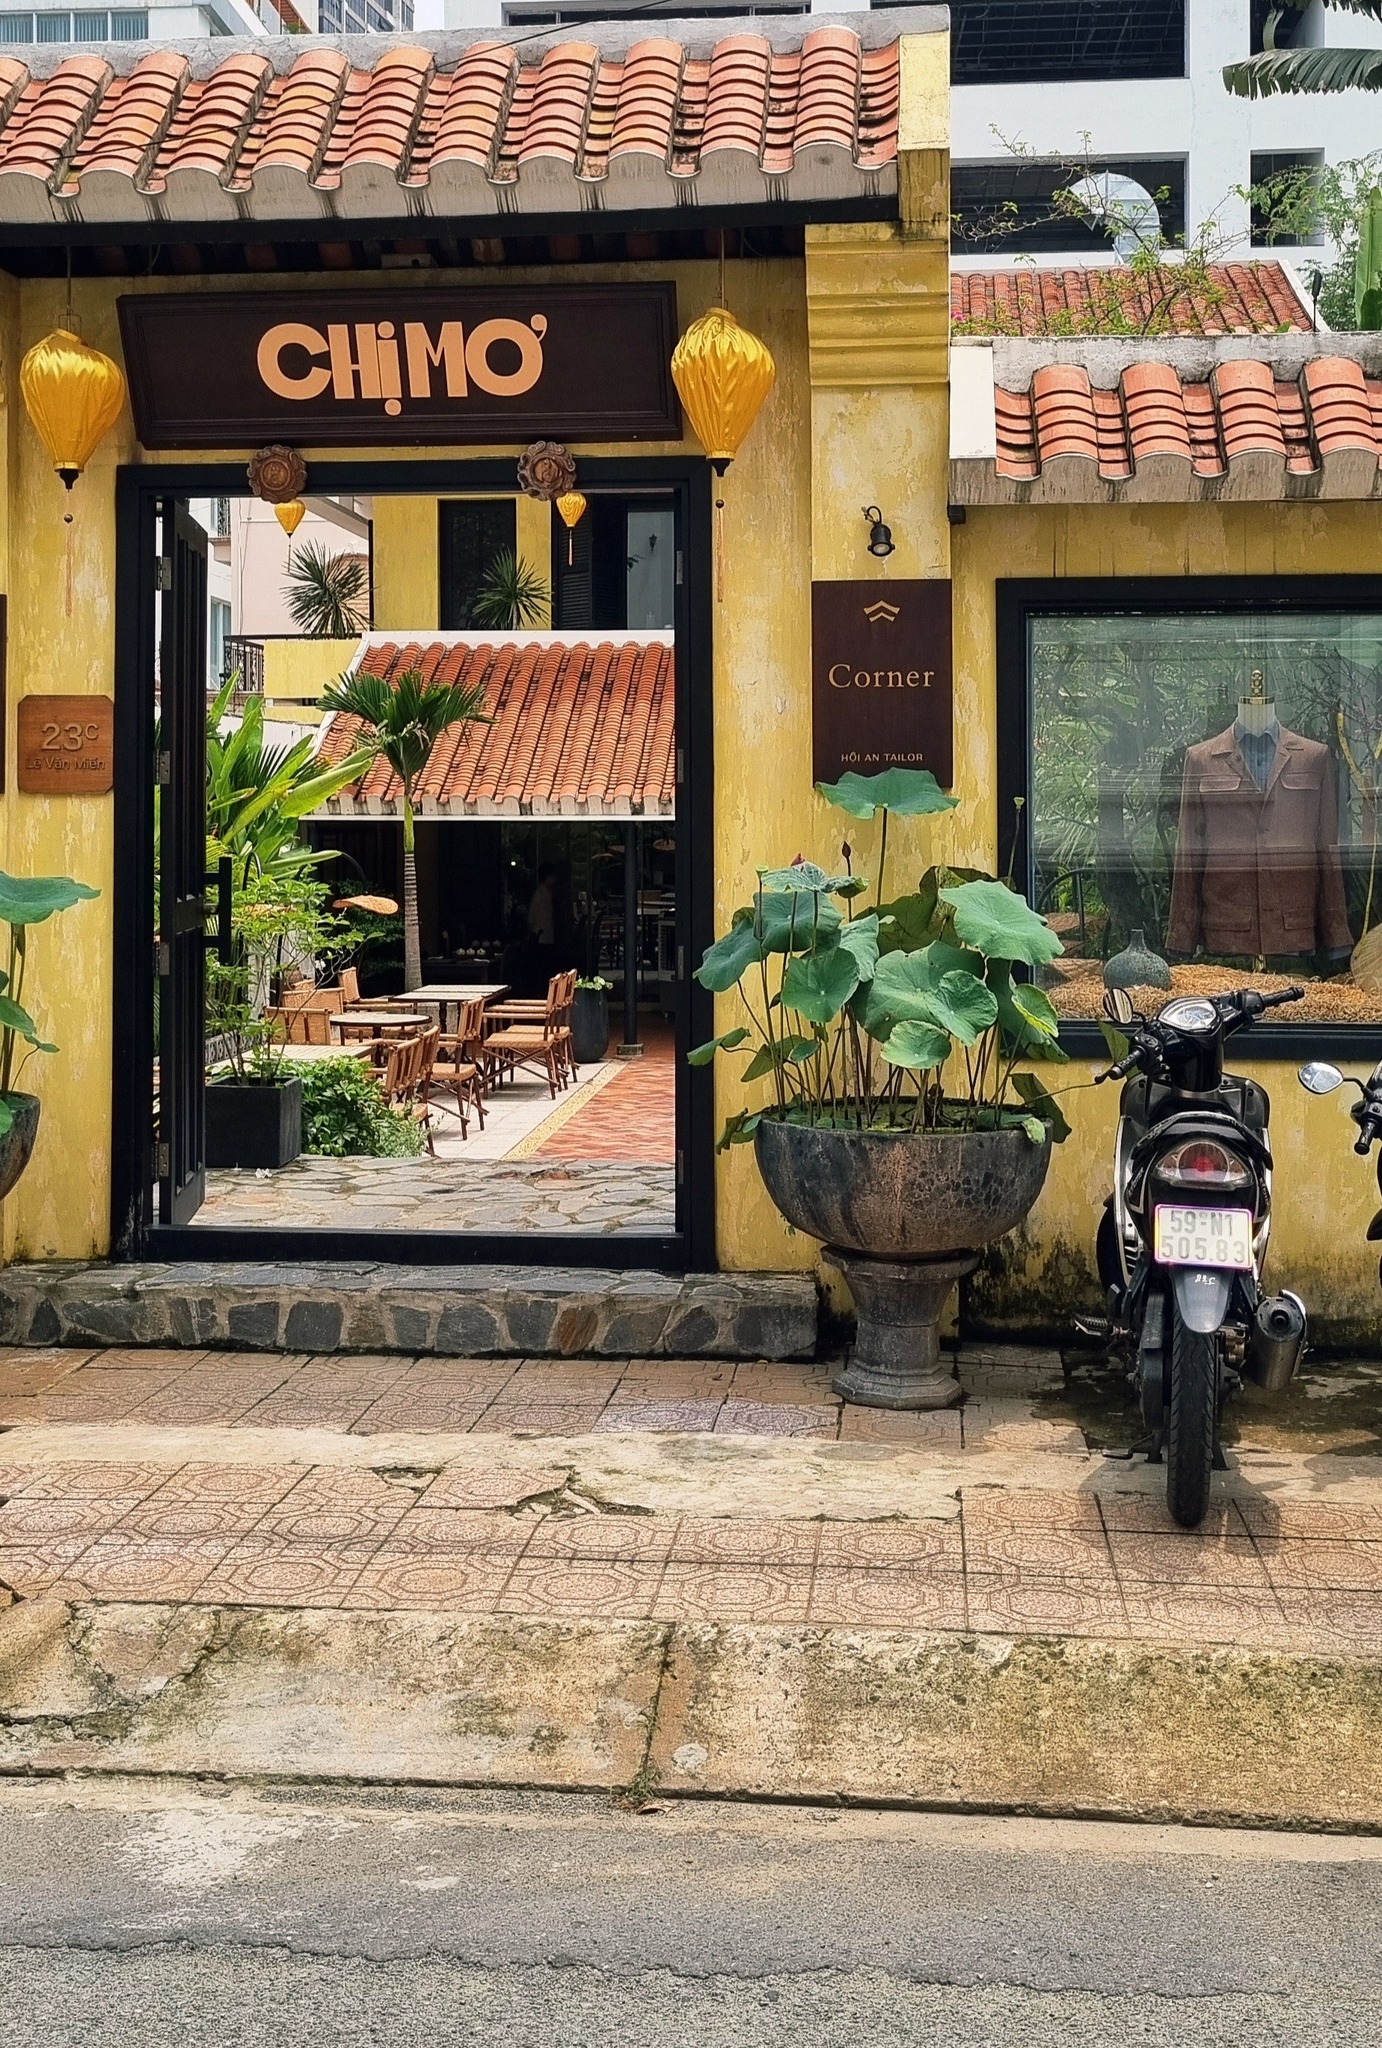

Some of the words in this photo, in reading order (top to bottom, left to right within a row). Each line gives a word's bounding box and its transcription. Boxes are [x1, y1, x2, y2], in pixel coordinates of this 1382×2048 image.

[404, 314, 547, 397] MƠ
[828, 663, 935, 688] Corner
[841, 751, 861, 763] HỘI
[864, 753, 880, 762] AN
[884, 753, 923, 762] TAILOR
[1170, 1210, 1233, 1236] 59-N1
[1161, 1235, 1245, 1263] 505.83
